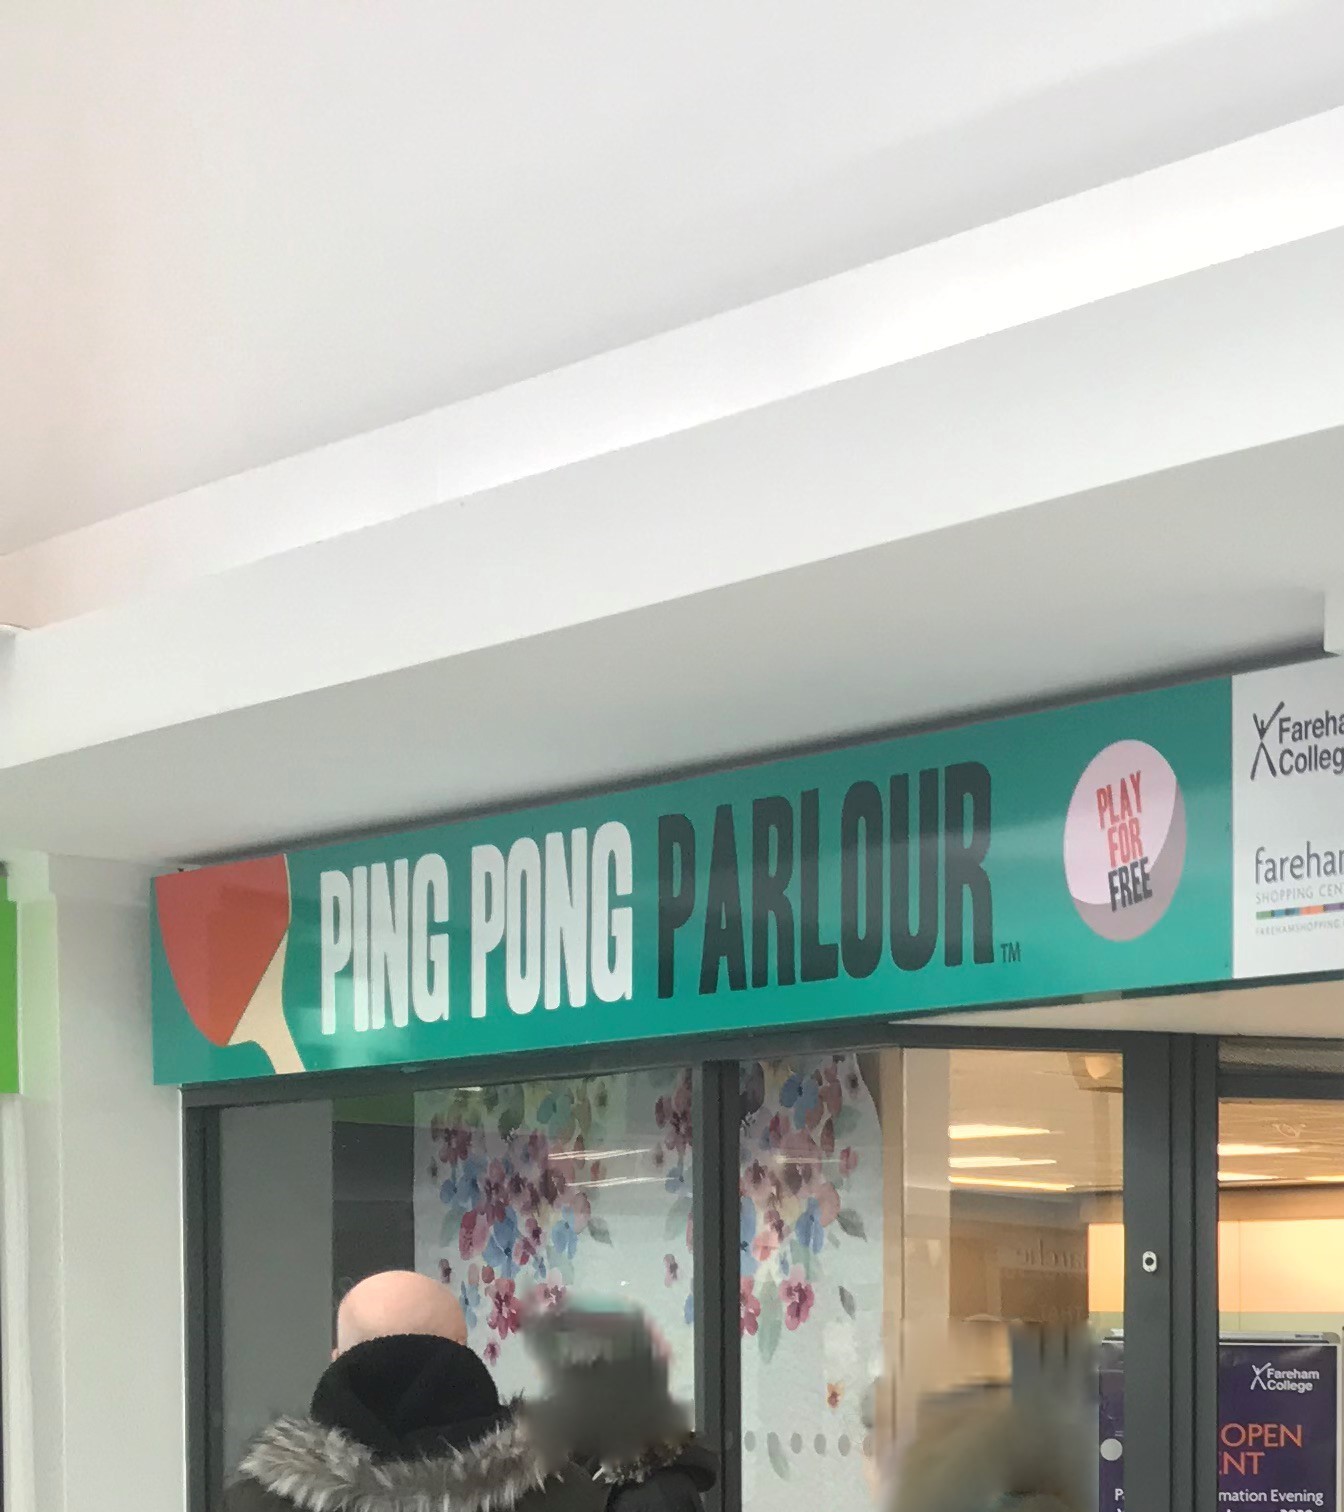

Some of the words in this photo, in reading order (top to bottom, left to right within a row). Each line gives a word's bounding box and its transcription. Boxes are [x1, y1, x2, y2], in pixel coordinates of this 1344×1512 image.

[1096, 769, 1143, 830] PLAY
[1107, 817, 1144, 868] FOR
[1108, 856, 1153, 913] FREE
[1256, 884, 1314, 904] SHOPPING
[319, 850, 450, 1036] PING
[469, 821, 635, 1018] PONG
[656, 760, 995, 1000] PARLOUR
[1267, 1368, 1320, 1380] Fareham
[1267, 1380, 1313, 1393] College
[1221, 1423, 1303, 1447] OPEN
[1218, 1489, 1267, 1502] mation
[1271, 1490, 1324, 1506] Evening
